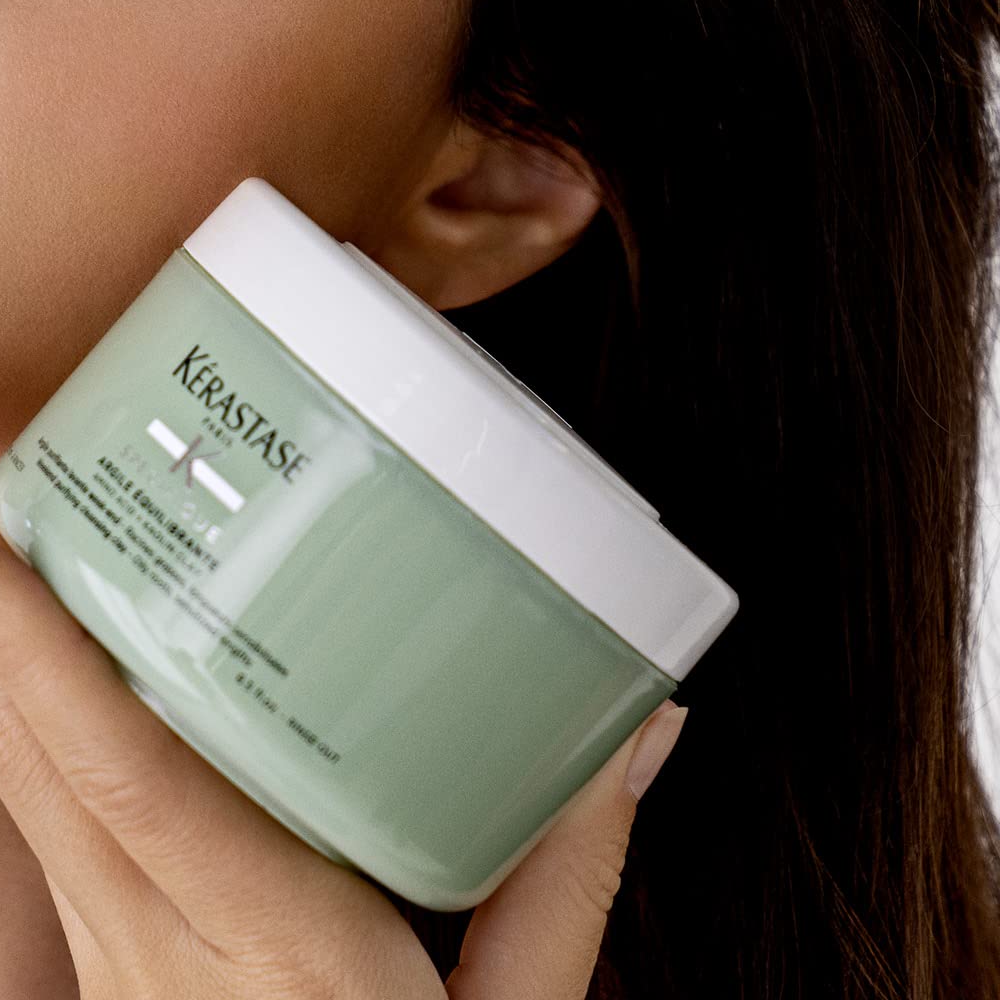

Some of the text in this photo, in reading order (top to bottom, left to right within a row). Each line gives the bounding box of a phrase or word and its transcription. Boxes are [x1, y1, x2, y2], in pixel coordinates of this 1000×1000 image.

[171, 344, 312, 484] KÉRASTASE
[201, 416, 233, 449] PARIS
[96, 456, 133, 491] ARGILE
